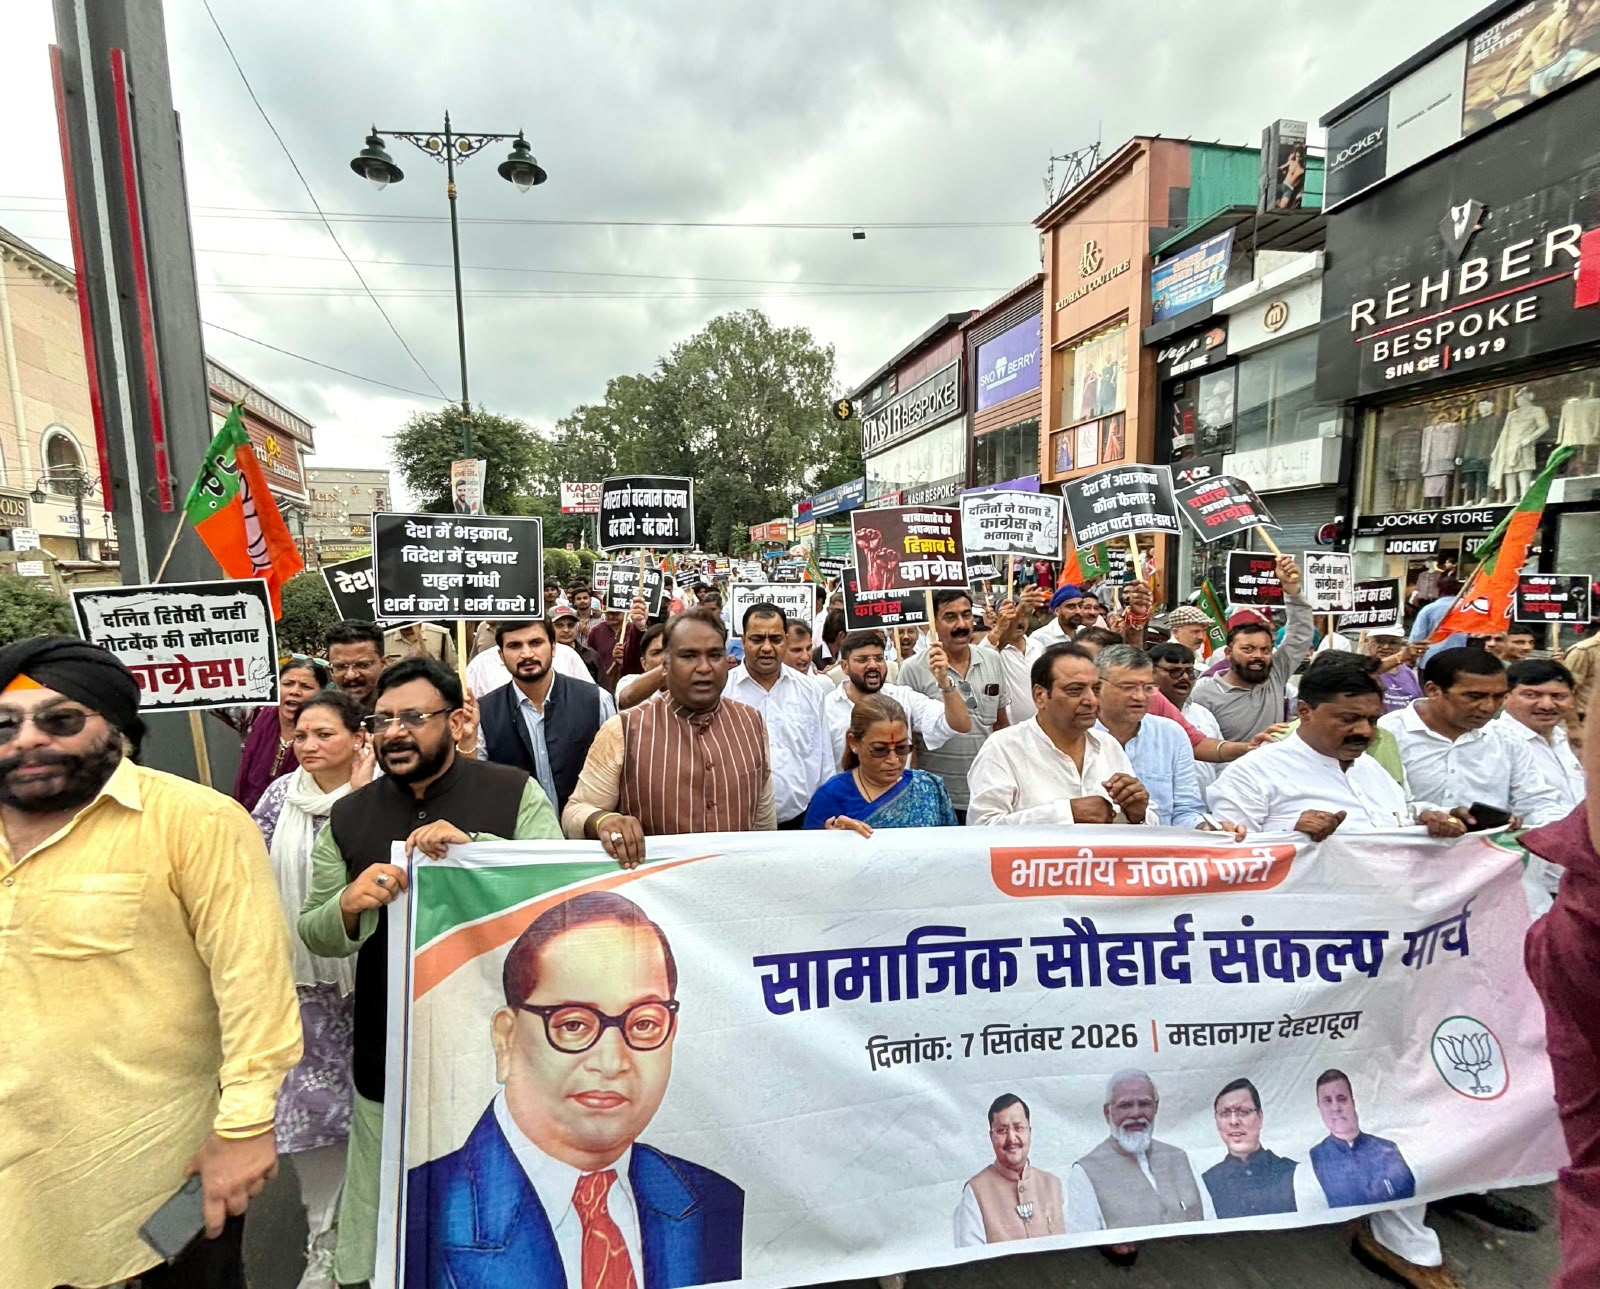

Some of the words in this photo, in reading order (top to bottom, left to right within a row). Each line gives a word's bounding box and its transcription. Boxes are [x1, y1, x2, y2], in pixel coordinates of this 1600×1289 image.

[1474, 1, 1536, 46] NOTHING
[1472, 28, 1523, 64] BETTER
[1474, 32, 1501, 55] FITS
[1330, 127, 1384, 167] JOCKEY
[1088, 258, 1131, 291] COUTURE
[1350, 224, 1583, 332] REHBER
[1373, 295, 1538, 363] BESPOKE
[1385, 355, 1440, 380] SINCE
[1452, 337, 1506, 362] 1979
[863, 403, 901, 451] NASIR
[903, 381, 954, 428] BESPOKE
[603, 490, 621, 510] भारत
[621, 483, 631, 508] को
[631, 489, 662, 508] बदनाम
[663, 489, 687, 508] करना
[925, 483, 956, 503] BESPOKE
[1081, 481, 1099, 497] देश
[1099, 473, 1111, 490] में
[968, 502, 1003, 515] दलितों
[1004, 502, 1015, 514] ने
[1018, 505, 1042, 517] ठाना
[1092, 496, 1117, 514] कौन
[609, 514, 620, 538] बंद
[619, 512, 635, 536] करो
[641, 513, 655, 536] बंद
[655, 512, 673, 537] करो
[980, 514, 1028, 530] कांग्रेस
[1028, 521, 1042, 532] को
[1078, 520, 1109, 542] कांग्रेस
[1108, 511, 1133, 529] पार्टी
[1377, 512, 1438, 528] JOCKEY
[1441, 511, 1494, 525] STORE
[404, 520, 432, 539] देश
[434, 521, 453, 539] में
[454, 525, 514, 543] भड़काव,
[984, 531, 1024, 542] भगाना
[401, 545, 445, 563] विदेश
[447, 546, 465, 564] में
[904, 535, 945, 554] हिसाब
[946, 536, 956, 554] दे
[1386, 539, 1438, 553] JOCKEY
[612, 571, 633, 583] राहुल
[899, 554, 963, 582] कांग्रेस
[421, 573, 465, 590] राहुल
[466, 570, 501, 588] गांधी
[613, 584, 653, 597] हाय-हय
[384, 594, 416, 611] शर्म
[417, 594, 450, 611] करो
[464, 594, 495, 611] शर्म
[495, 594, 527, 611] करो
[776, 595, 797, 603] ठाना
[854, 600, 903, 617] कांग्रेस
[101, 608, 151, 628] दलित
[154, 603, 206, 625] हितैषी
[210, 601, 249, 621] नहीं
[162, 630, 185, 649] की
[188, 628, 260, 647] सौदागर
[1011, 848, 1119, 888] भारतीय
[1123, 858, 1209, 888] जनता
[1213, 848, 1277, 884] पार्टी
[752, 925, 1022, 1016] सामाजिक
[1030, 913, 1195, 989] सौहार्द
[1203, 915, 1389, 984] संकल्प
[1401, 894, 1477, 971] मार्च
[866, 1032, 953, 1072] दिनांक:
[960, 1032, 975, 1058] 7
[979, 1022, 1064, 1056] सितंबर
[1070, 1023, 1138, 1050] 2026
[1165, 1021, 1275, 1048] महानगर
[1278, 1010, 1363, 1040] देहरादून
